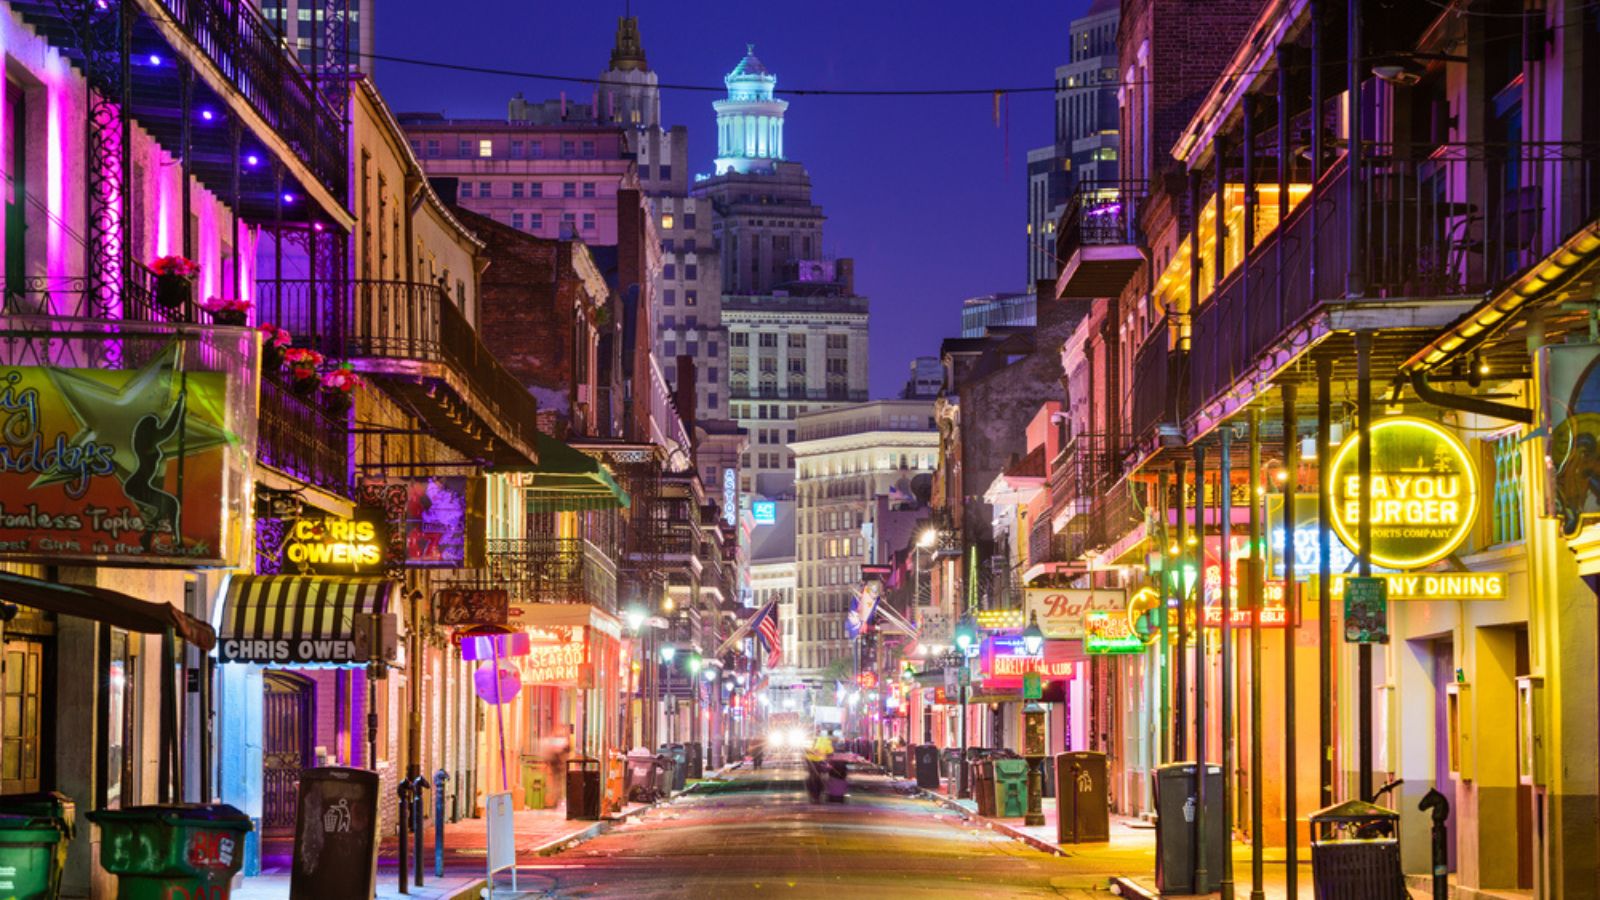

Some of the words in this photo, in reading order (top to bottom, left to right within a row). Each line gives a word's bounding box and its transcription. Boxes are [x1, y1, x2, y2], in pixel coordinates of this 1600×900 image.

[1345, 475, 1458, 499] BAYOU
[1345, 500, 1459, 524] BURGER
[297, 521, 375, 541] CRIS
[1403, 528, 1451, 539] COMPANY
[287, 543, 381, 565] OWENS
[1424, 576, 1502, 596] DINING
[224, 640, 289, 659] CHRIS
[298, 640, 356, 660] OWEN
